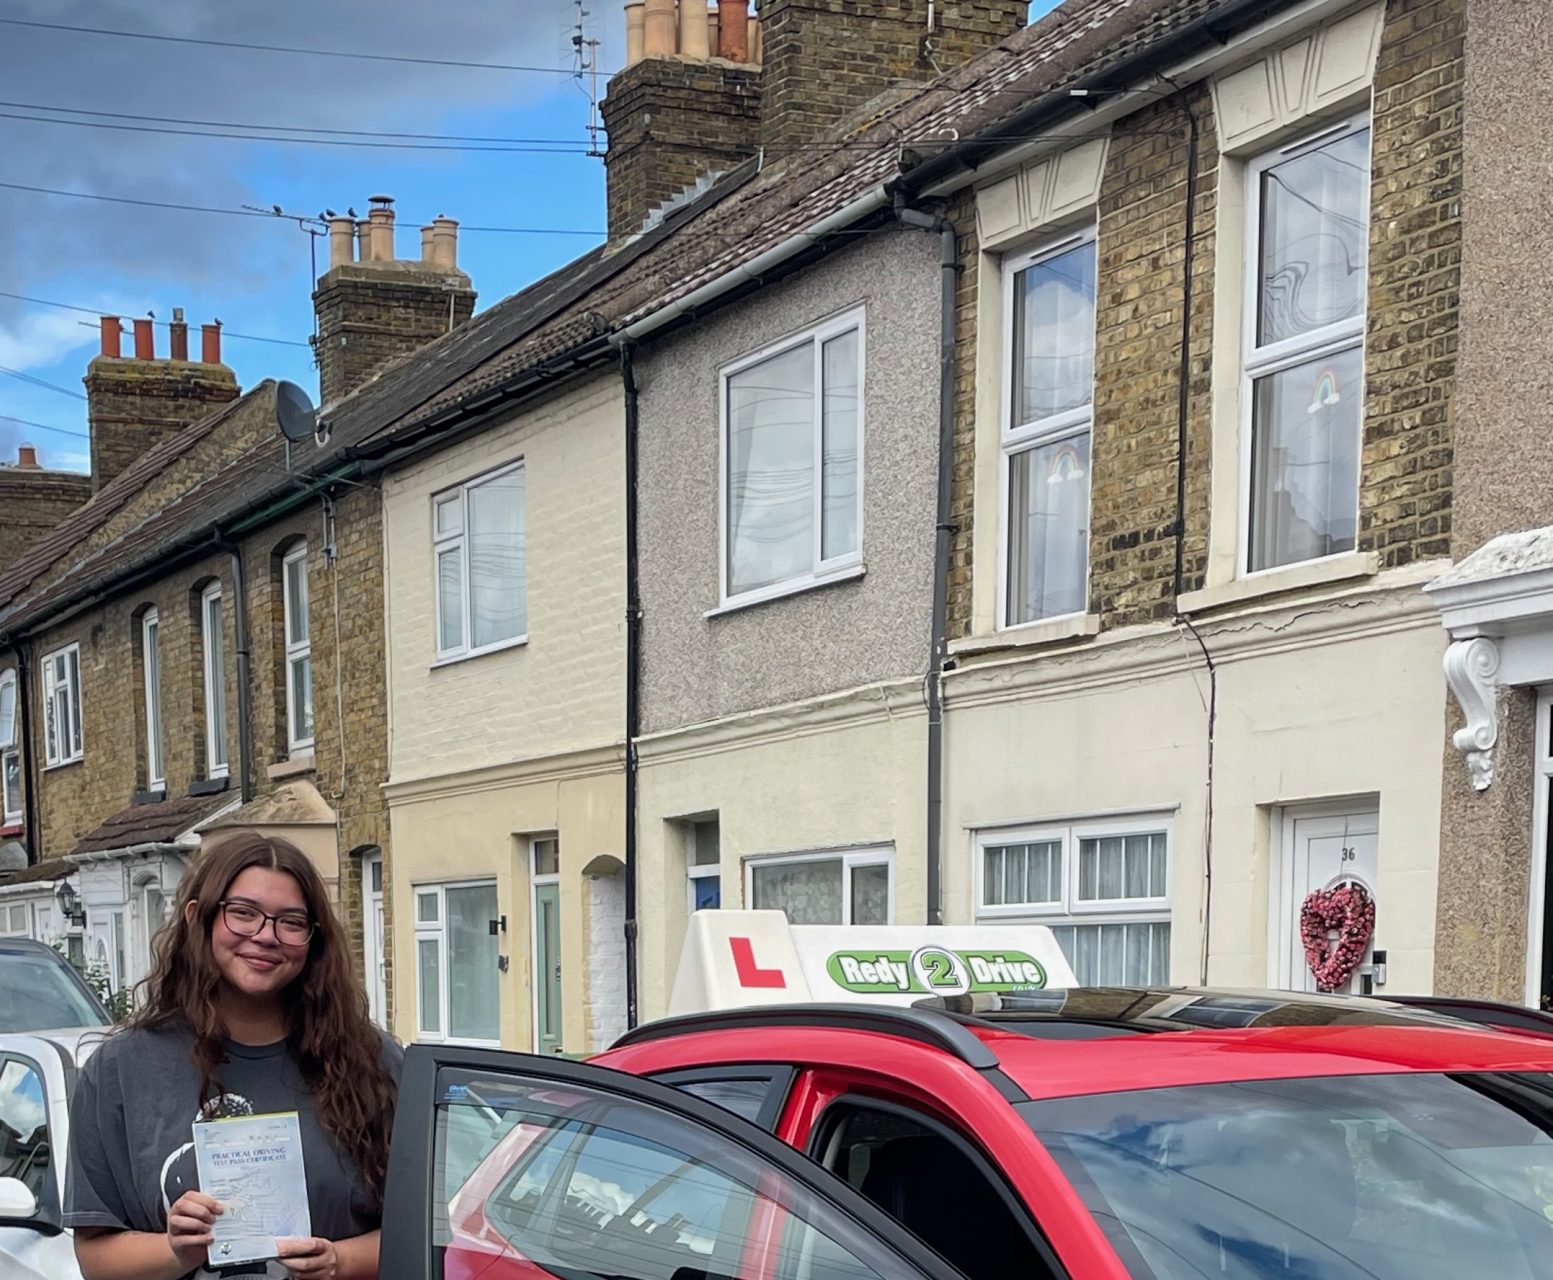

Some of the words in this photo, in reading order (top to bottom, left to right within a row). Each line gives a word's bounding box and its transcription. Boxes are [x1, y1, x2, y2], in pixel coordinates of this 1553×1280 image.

[1341, 847, 1356, 861] 36
[728, 936, 787, 989] L
[841, 955, 911, 990] Redy
[920, 952, 963, 989] 2
[968, 956, 1042, 986] Drive
[212, 1149, 251, 1160] PRACTICAL
[253, 1147, 286, 1157] DRIVING
[213, 1159, 228, 1167] TEST
[246, 1154, 286, 1164] CERTIFICATE
